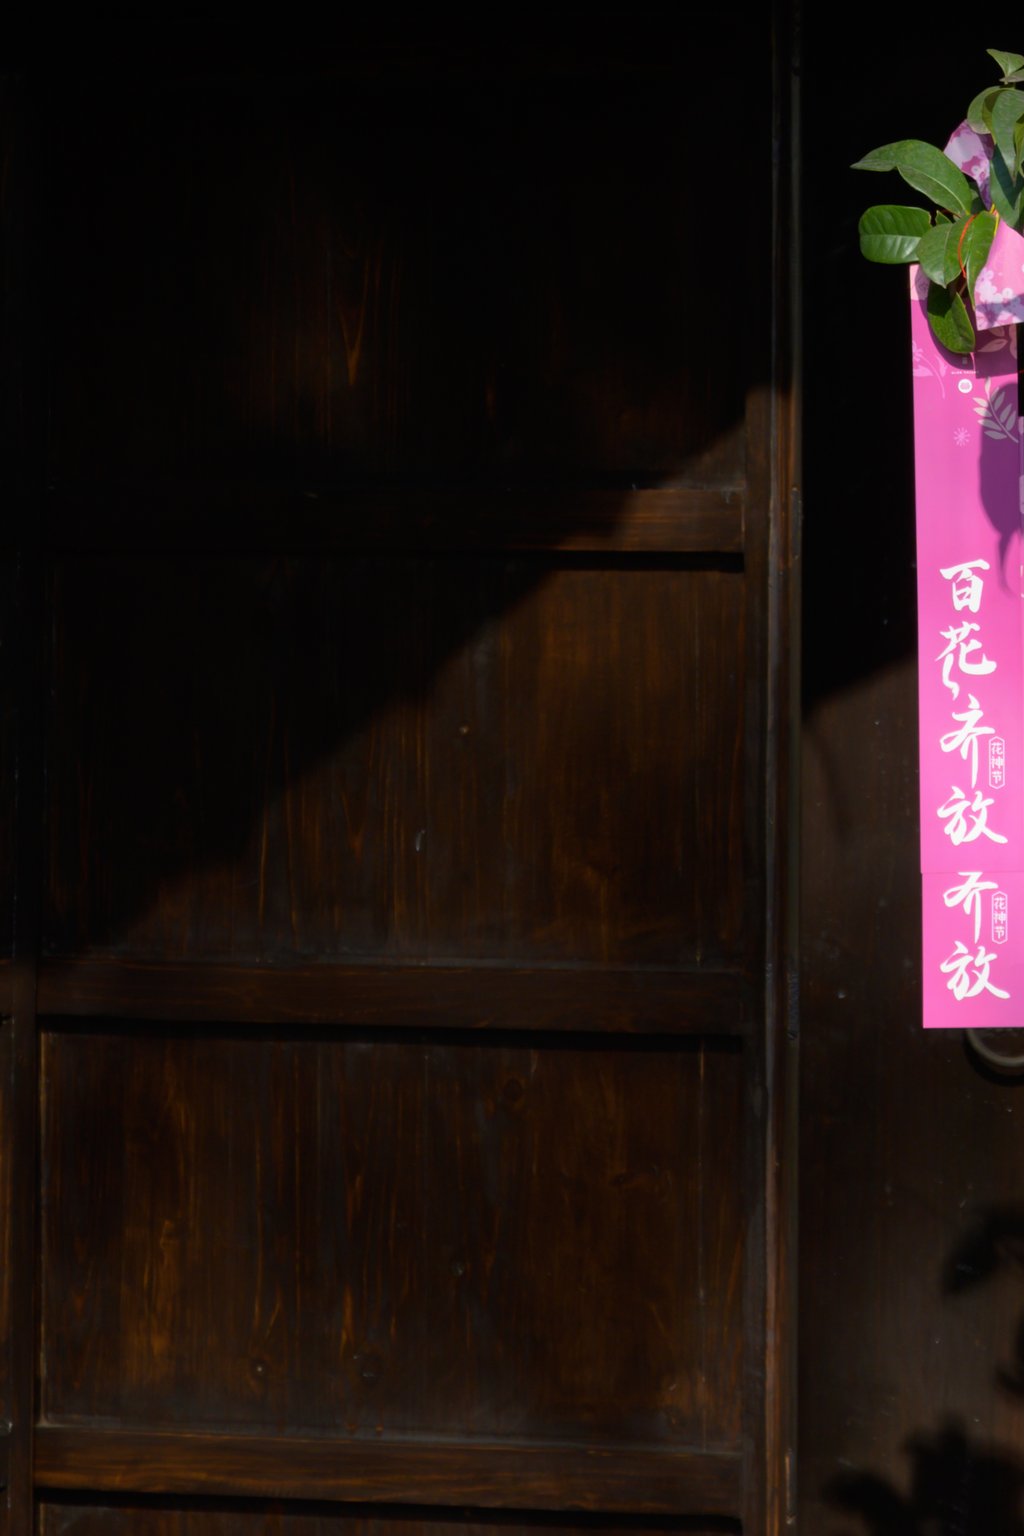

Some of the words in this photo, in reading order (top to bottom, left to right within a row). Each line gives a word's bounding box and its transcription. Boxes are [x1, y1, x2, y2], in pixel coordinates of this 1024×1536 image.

[934, 559, 1008, 846] 百花齐放
[990, 742, 1004, 785] 花神节
[940, 871, 1010, 1001] 齐放
[993, 897, 1007, 939] 花神节
